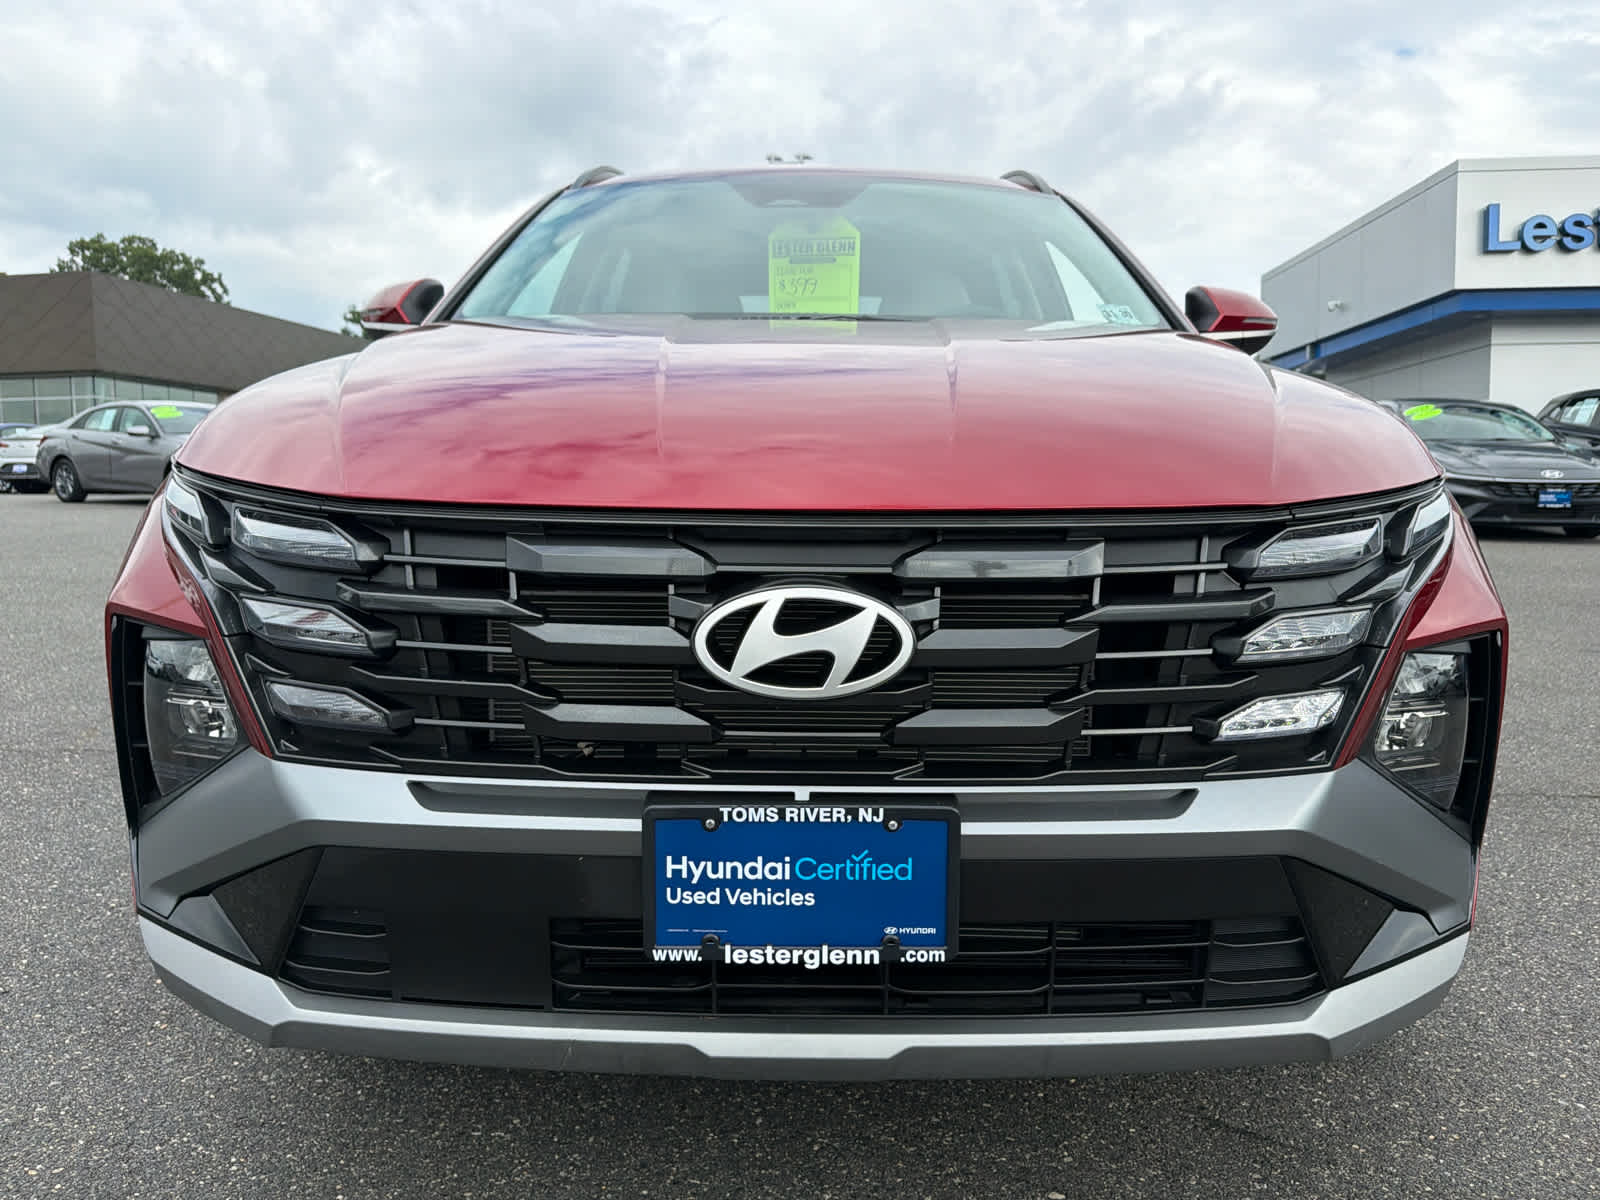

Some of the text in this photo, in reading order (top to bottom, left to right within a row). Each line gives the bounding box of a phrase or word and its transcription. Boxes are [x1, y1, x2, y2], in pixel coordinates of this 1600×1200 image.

[1487, 203, 1600, 252] Les
[816, 239, 856, 256] GLENN
[719, 807, 885, 823] TOMS RIVER, NJ
[665, 849, 913, 884] Hyundai Certified
[665, 887, 816, 906] Used Vehicles
[899, 927, 937, 935] HYUNDAI
[652, 944, 946, 970] www. lesterglenn .com
